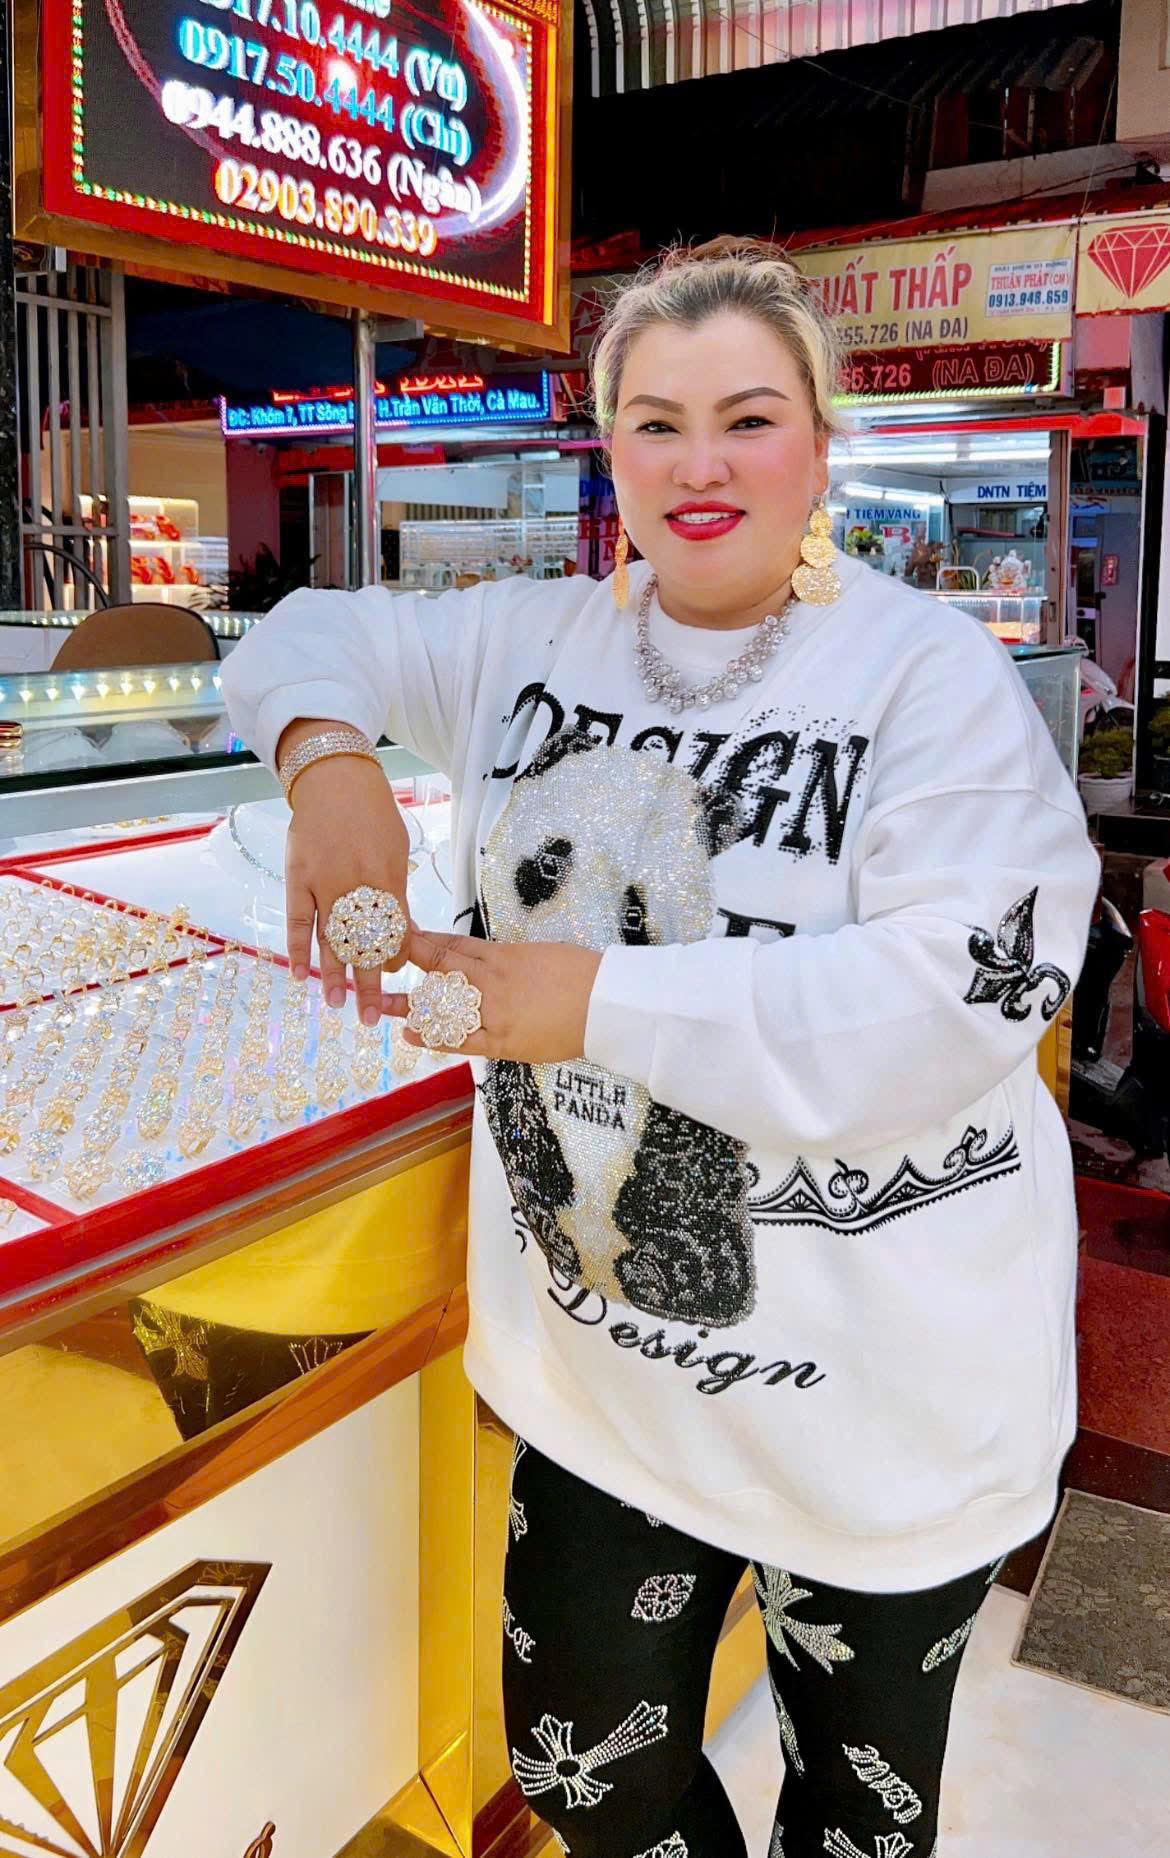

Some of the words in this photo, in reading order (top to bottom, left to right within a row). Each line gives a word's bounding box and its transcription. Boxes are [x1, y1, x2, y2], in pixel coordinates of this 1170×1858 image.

[199, 0, 399, 78] 17.10.4444
[179, 18, 395, 132] 0917.50.4444
[161, 79, 382, 185] 0944.888.636
[215, 157, 437, 256] 02903.890.339
[889, 245, 973, 312] THẤP
[905, 319, 933, 343] (NA
[939, 316, 968, 341] ĐA)
[932, 359, 979, 391] (NA
[984, 353, 1034, 385] ĐA)
[316, 400, 347, 424] Sông
[507, 387, 540, 409] Mau.
[977, 486, 1010, 499] DNTN
[556, 1067, 627, 1107] LITTLE
[553, 1090, 627, 1130] PANDA
